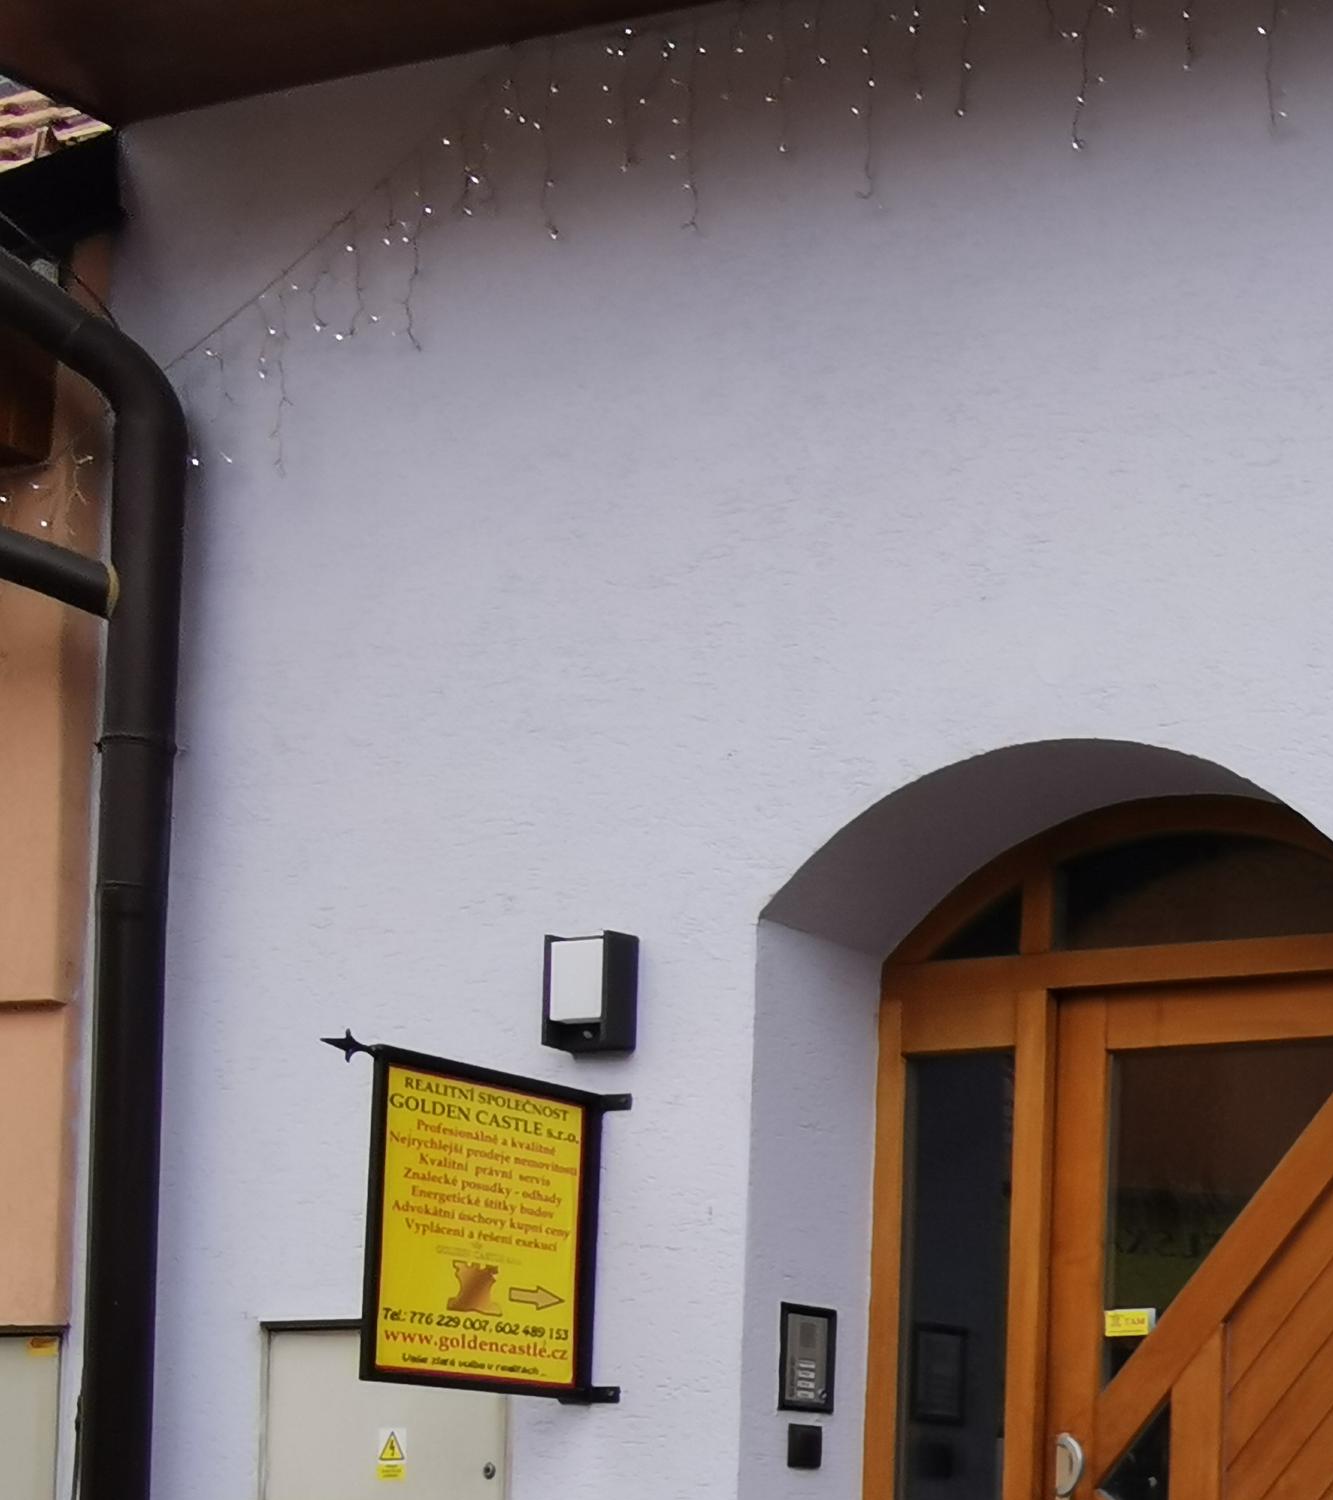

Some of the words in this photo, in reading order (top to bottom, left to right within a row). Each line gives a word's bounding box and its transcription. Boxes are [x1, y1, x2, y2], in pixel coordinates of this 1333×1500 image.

[405, 1077, 475, 1101] REALITNÍ
[478, 1091, 569, 1121] SPOLEČNOST
[389, 1092, 471, 1121] GOLDEN
[476, 1110, 543, 1136] CASTLE
[547, 1127, 580, 1144] s.r.o.
[410, 1311, 432, 1325] 776
[436, 1315, 459, 1328] 229
[495, 1322, 519, 1335] 602
[550, 1328, 568, 1340] 153
[384, 1330, 569, 1361] www.goldencastle.cz
